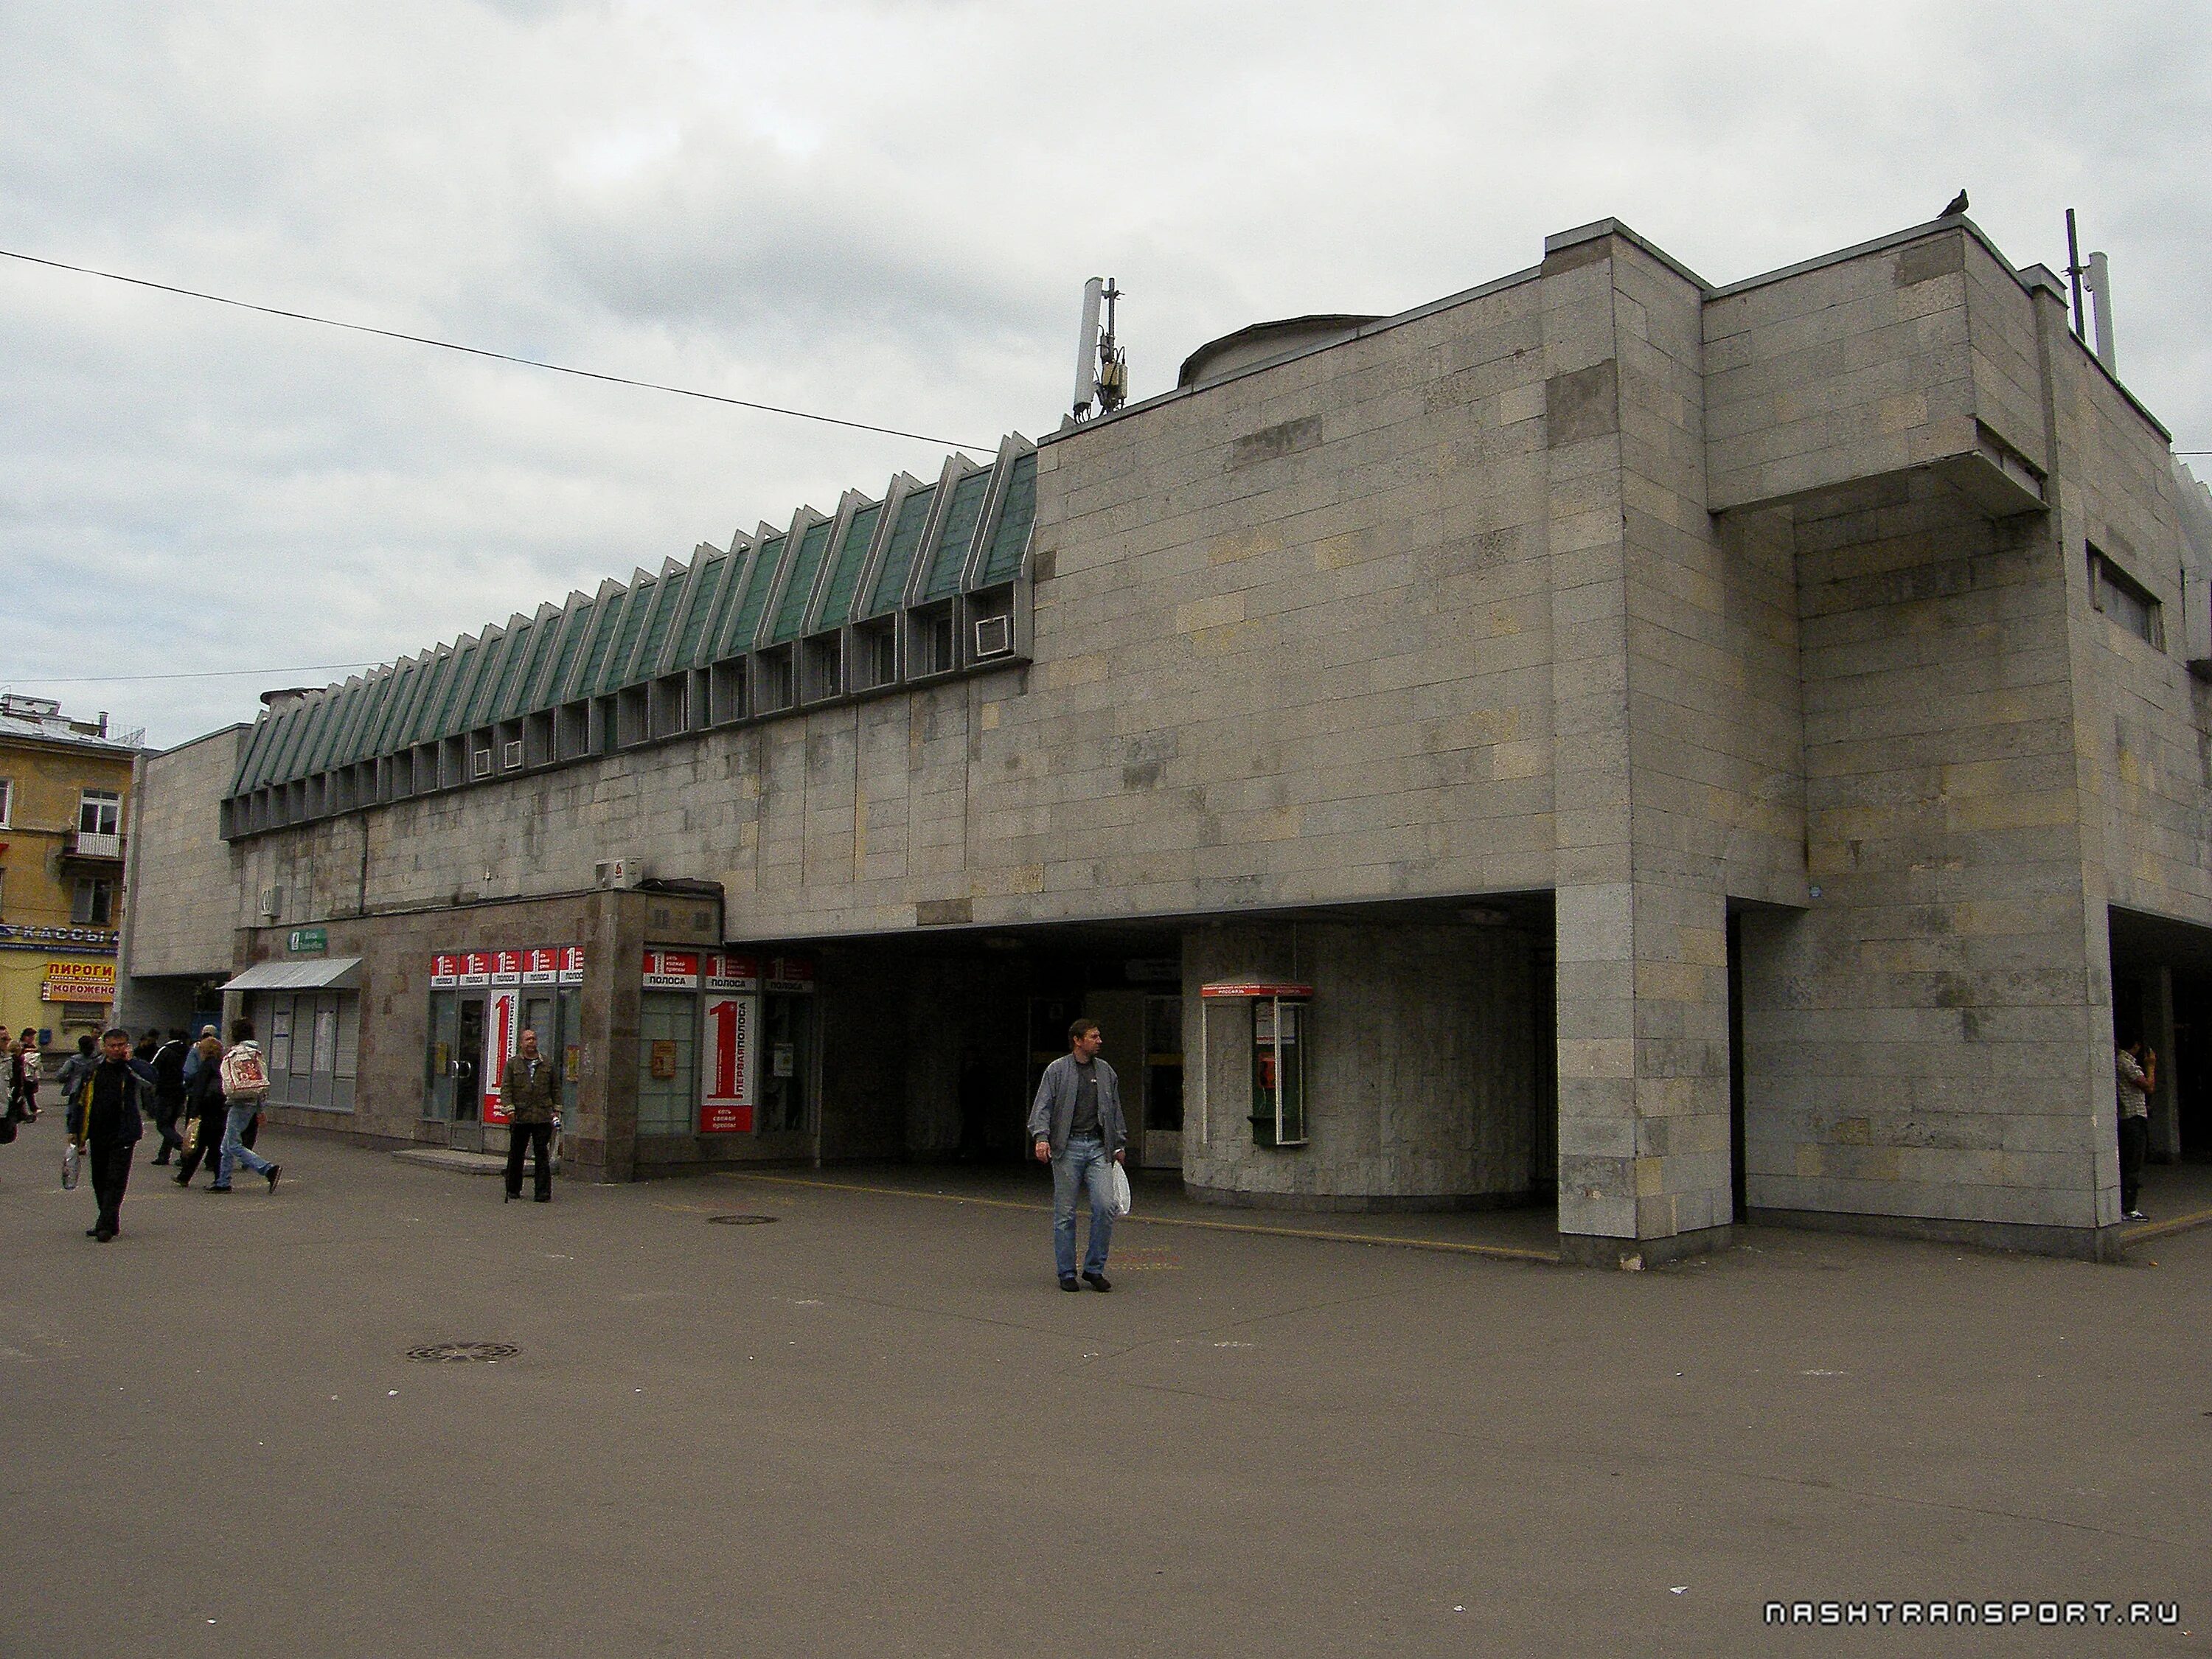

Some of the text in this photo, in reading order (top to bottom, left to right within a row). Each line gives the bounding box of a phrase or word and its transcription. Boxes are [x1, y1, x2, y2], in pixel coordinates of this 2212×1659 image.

[24, 925, 105, 942] КАССЫ
[437, 956, 445, 975] 1
[467, 953, 475, 974] 1
[498, 952, 506, 973] 1
[532, 950, 540, 972] 1
[566, 947, 575, 970] 1
[650, 953, 664, 974] 1
[713, 956, 726, 977] 1
[49, 964, 113, 975] ПИРОГИ
[649, 975, 686, 984] ПОЛОСА
[712, 978, 746, 987] ПОЛОСА
[707, 1001, 743, 1099] 1
